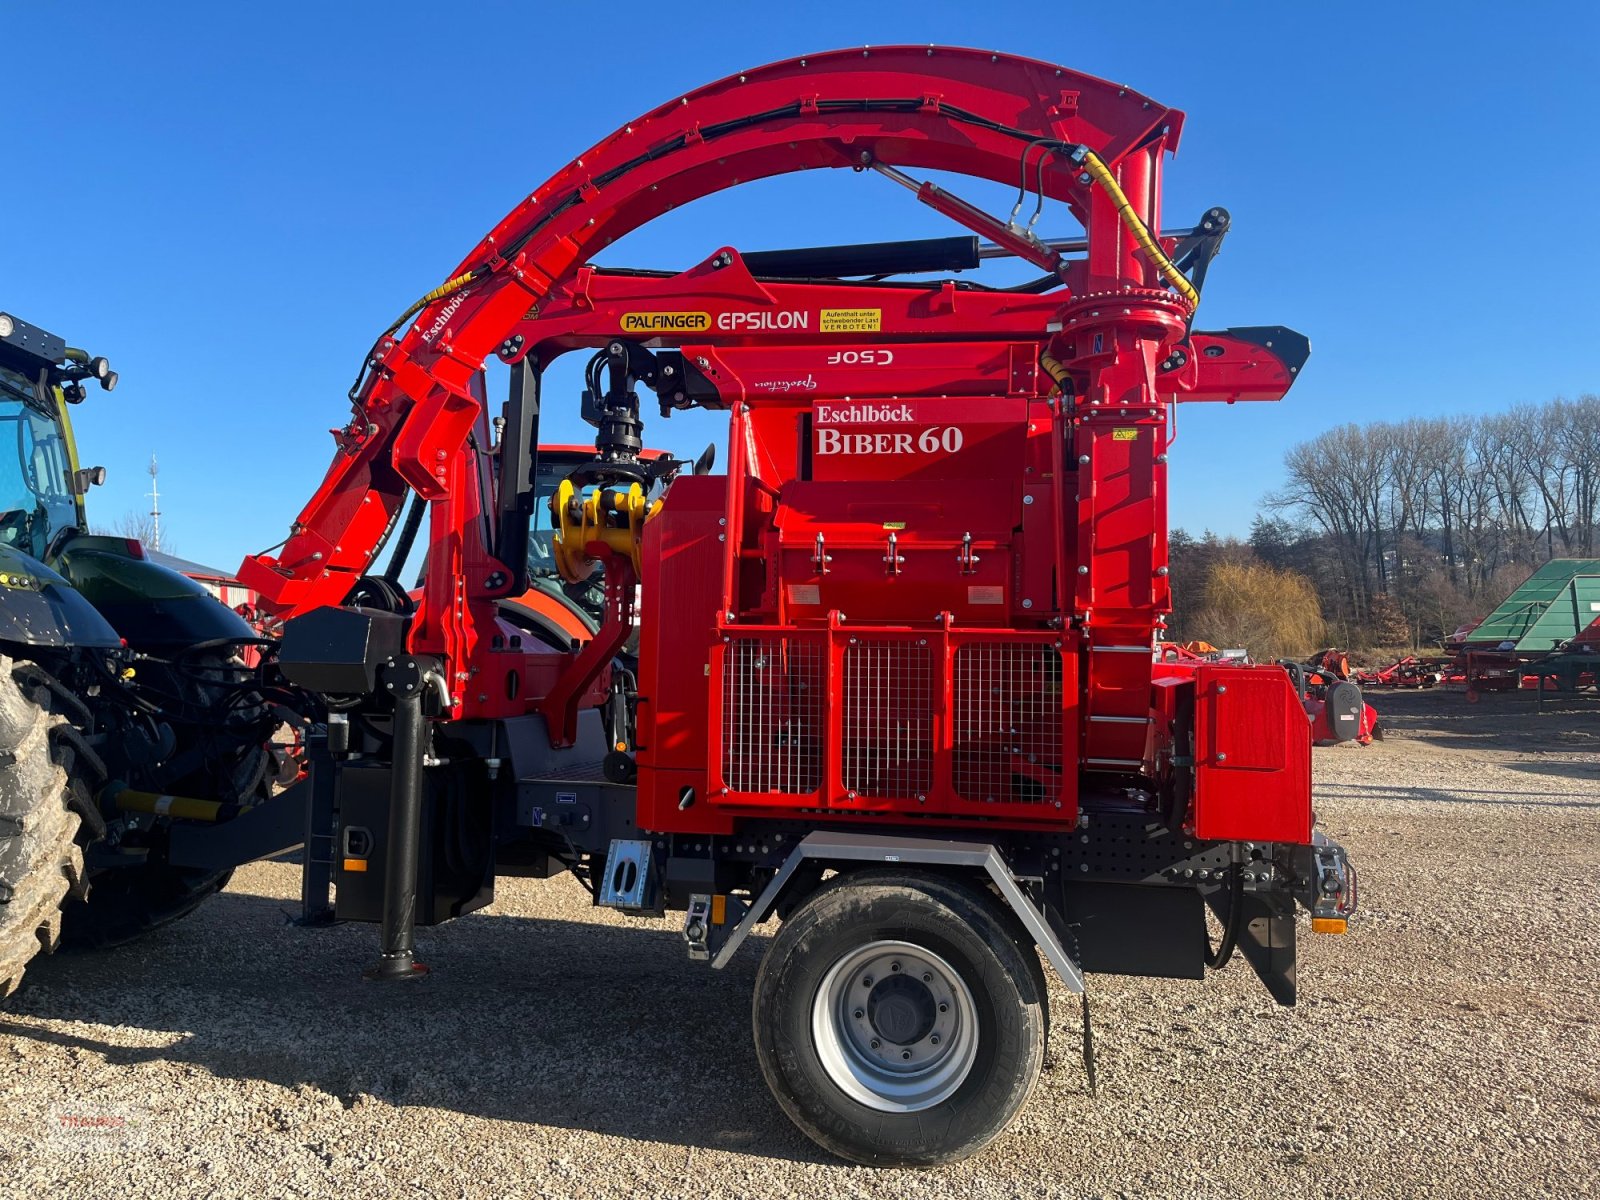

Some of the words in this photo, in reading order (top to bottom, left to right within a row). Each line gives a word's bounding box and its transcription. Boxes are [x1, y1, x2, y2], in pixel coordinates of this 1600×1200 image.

[625, 315, 706, 329] PALFINGER
[717, 311, 808, 330] EPSILON
[827, 350, 894, 366] C50F
[817, 404, 914, 424] Eschlböck
[815, 428, 916, 455] BIBER
[918, 426, 964, 454] 60
